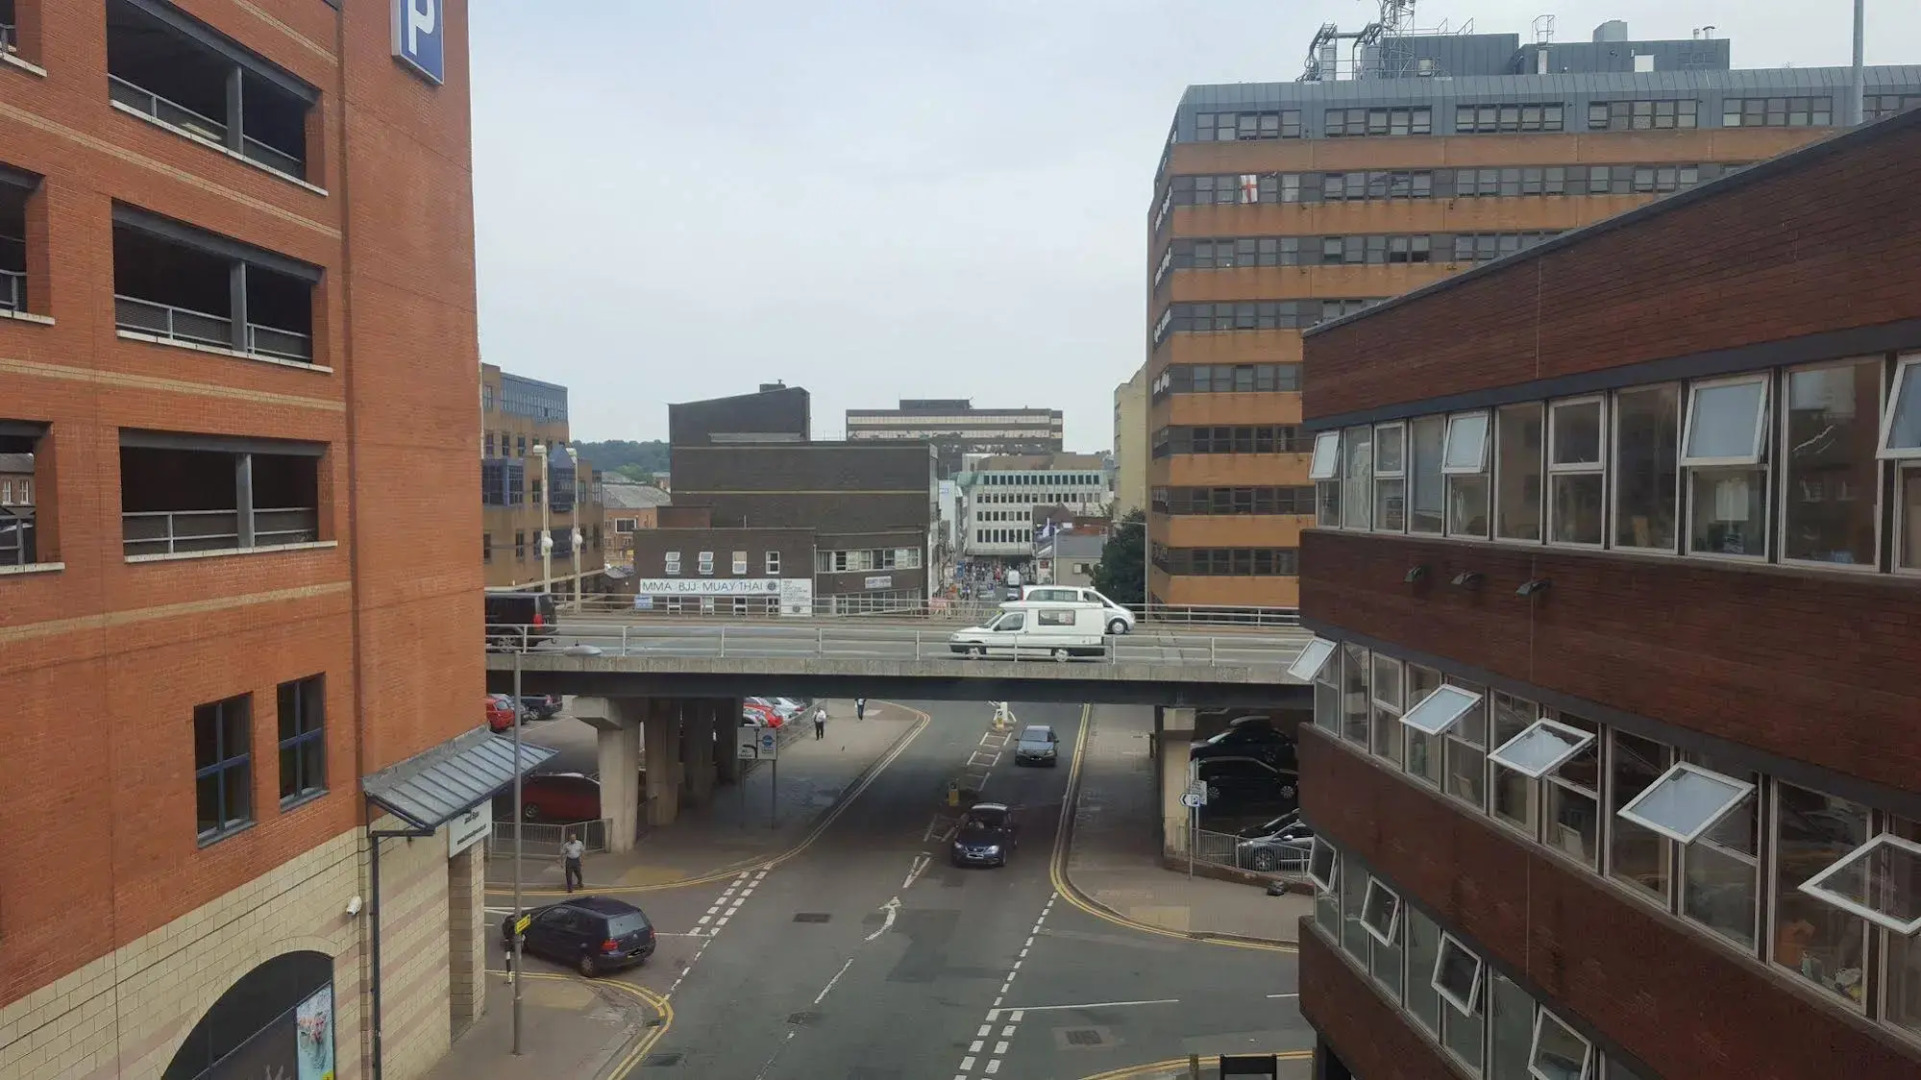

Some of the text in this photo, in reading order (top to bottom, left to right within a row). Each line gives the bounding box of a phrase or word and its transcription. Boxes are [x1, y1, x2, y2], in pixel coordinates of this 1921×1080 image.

[407, 0, 435, 56] P
[642, 581, 763, 592] MMA BJJ MUAY THAI
